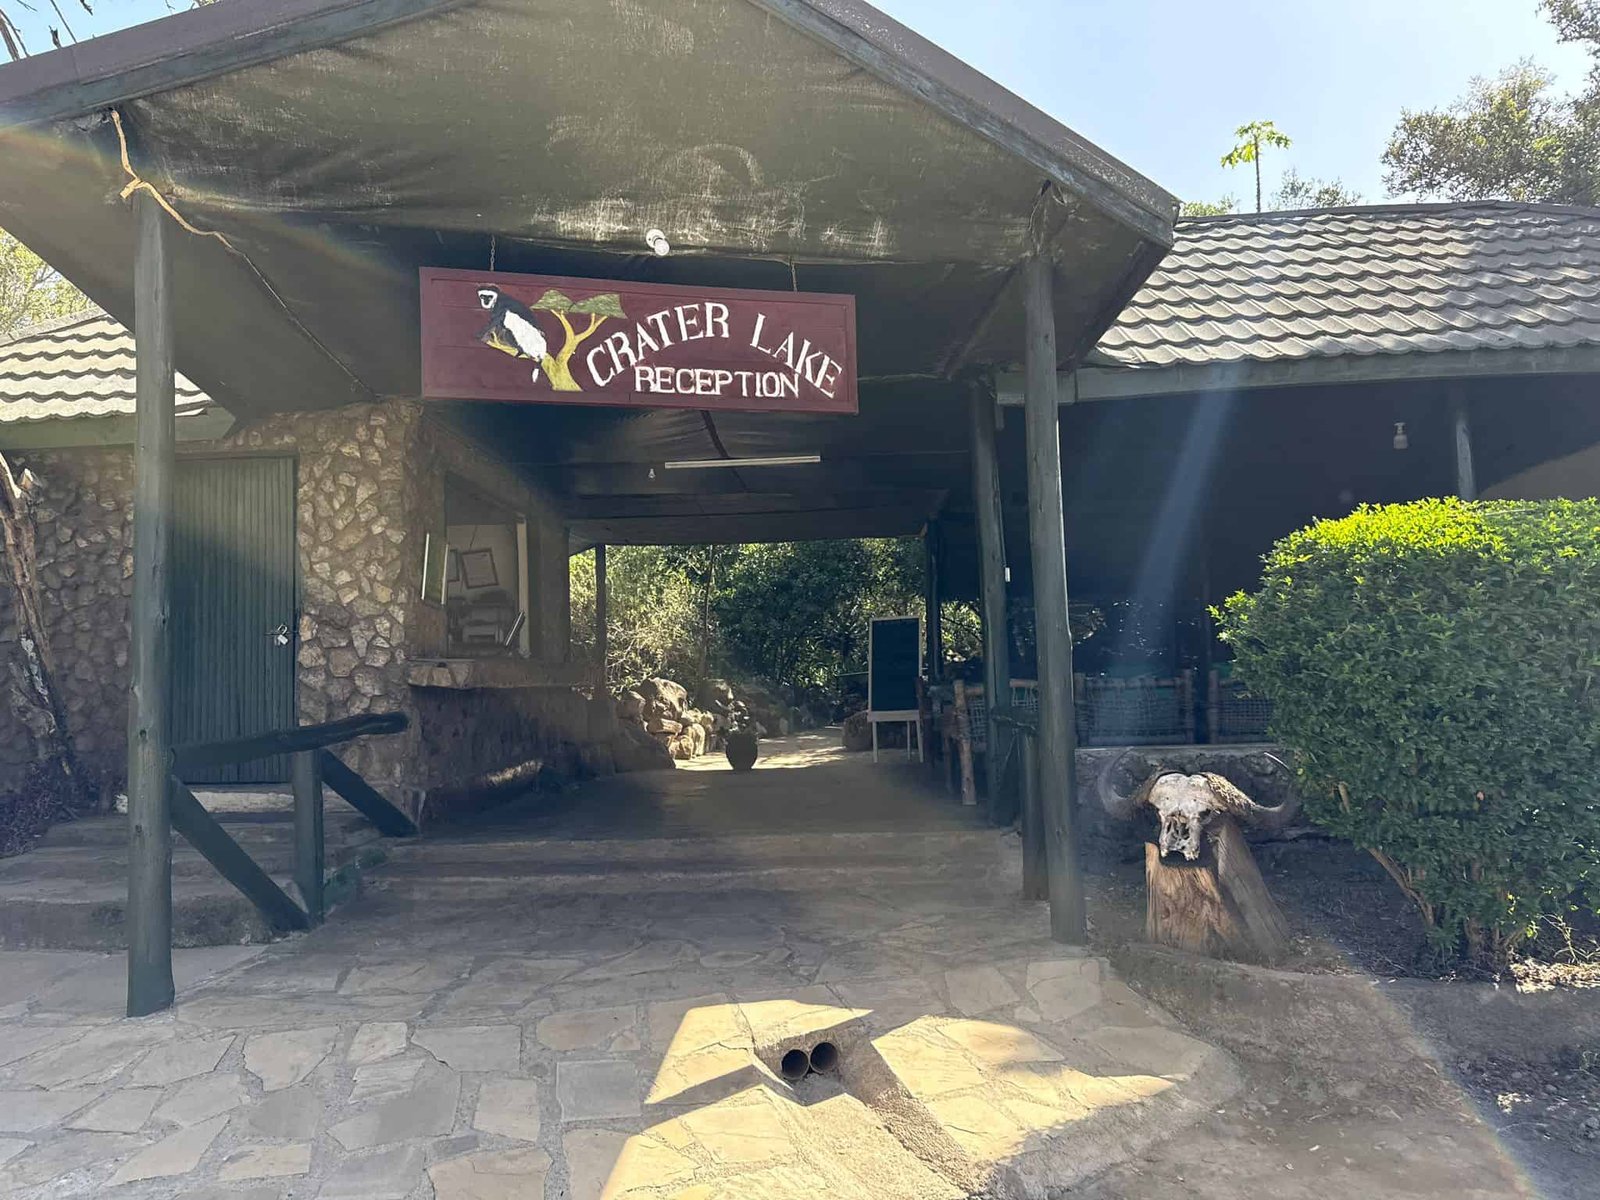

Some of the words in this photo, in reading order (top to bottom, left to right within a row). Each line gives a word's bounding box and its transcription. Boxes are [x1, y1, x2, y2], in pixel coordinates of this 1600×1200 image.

[586, 302, 729, 387] CRATER
[750, 314, 842, 398] LAKE
[634, 366, 800, 398] RECEPTION
